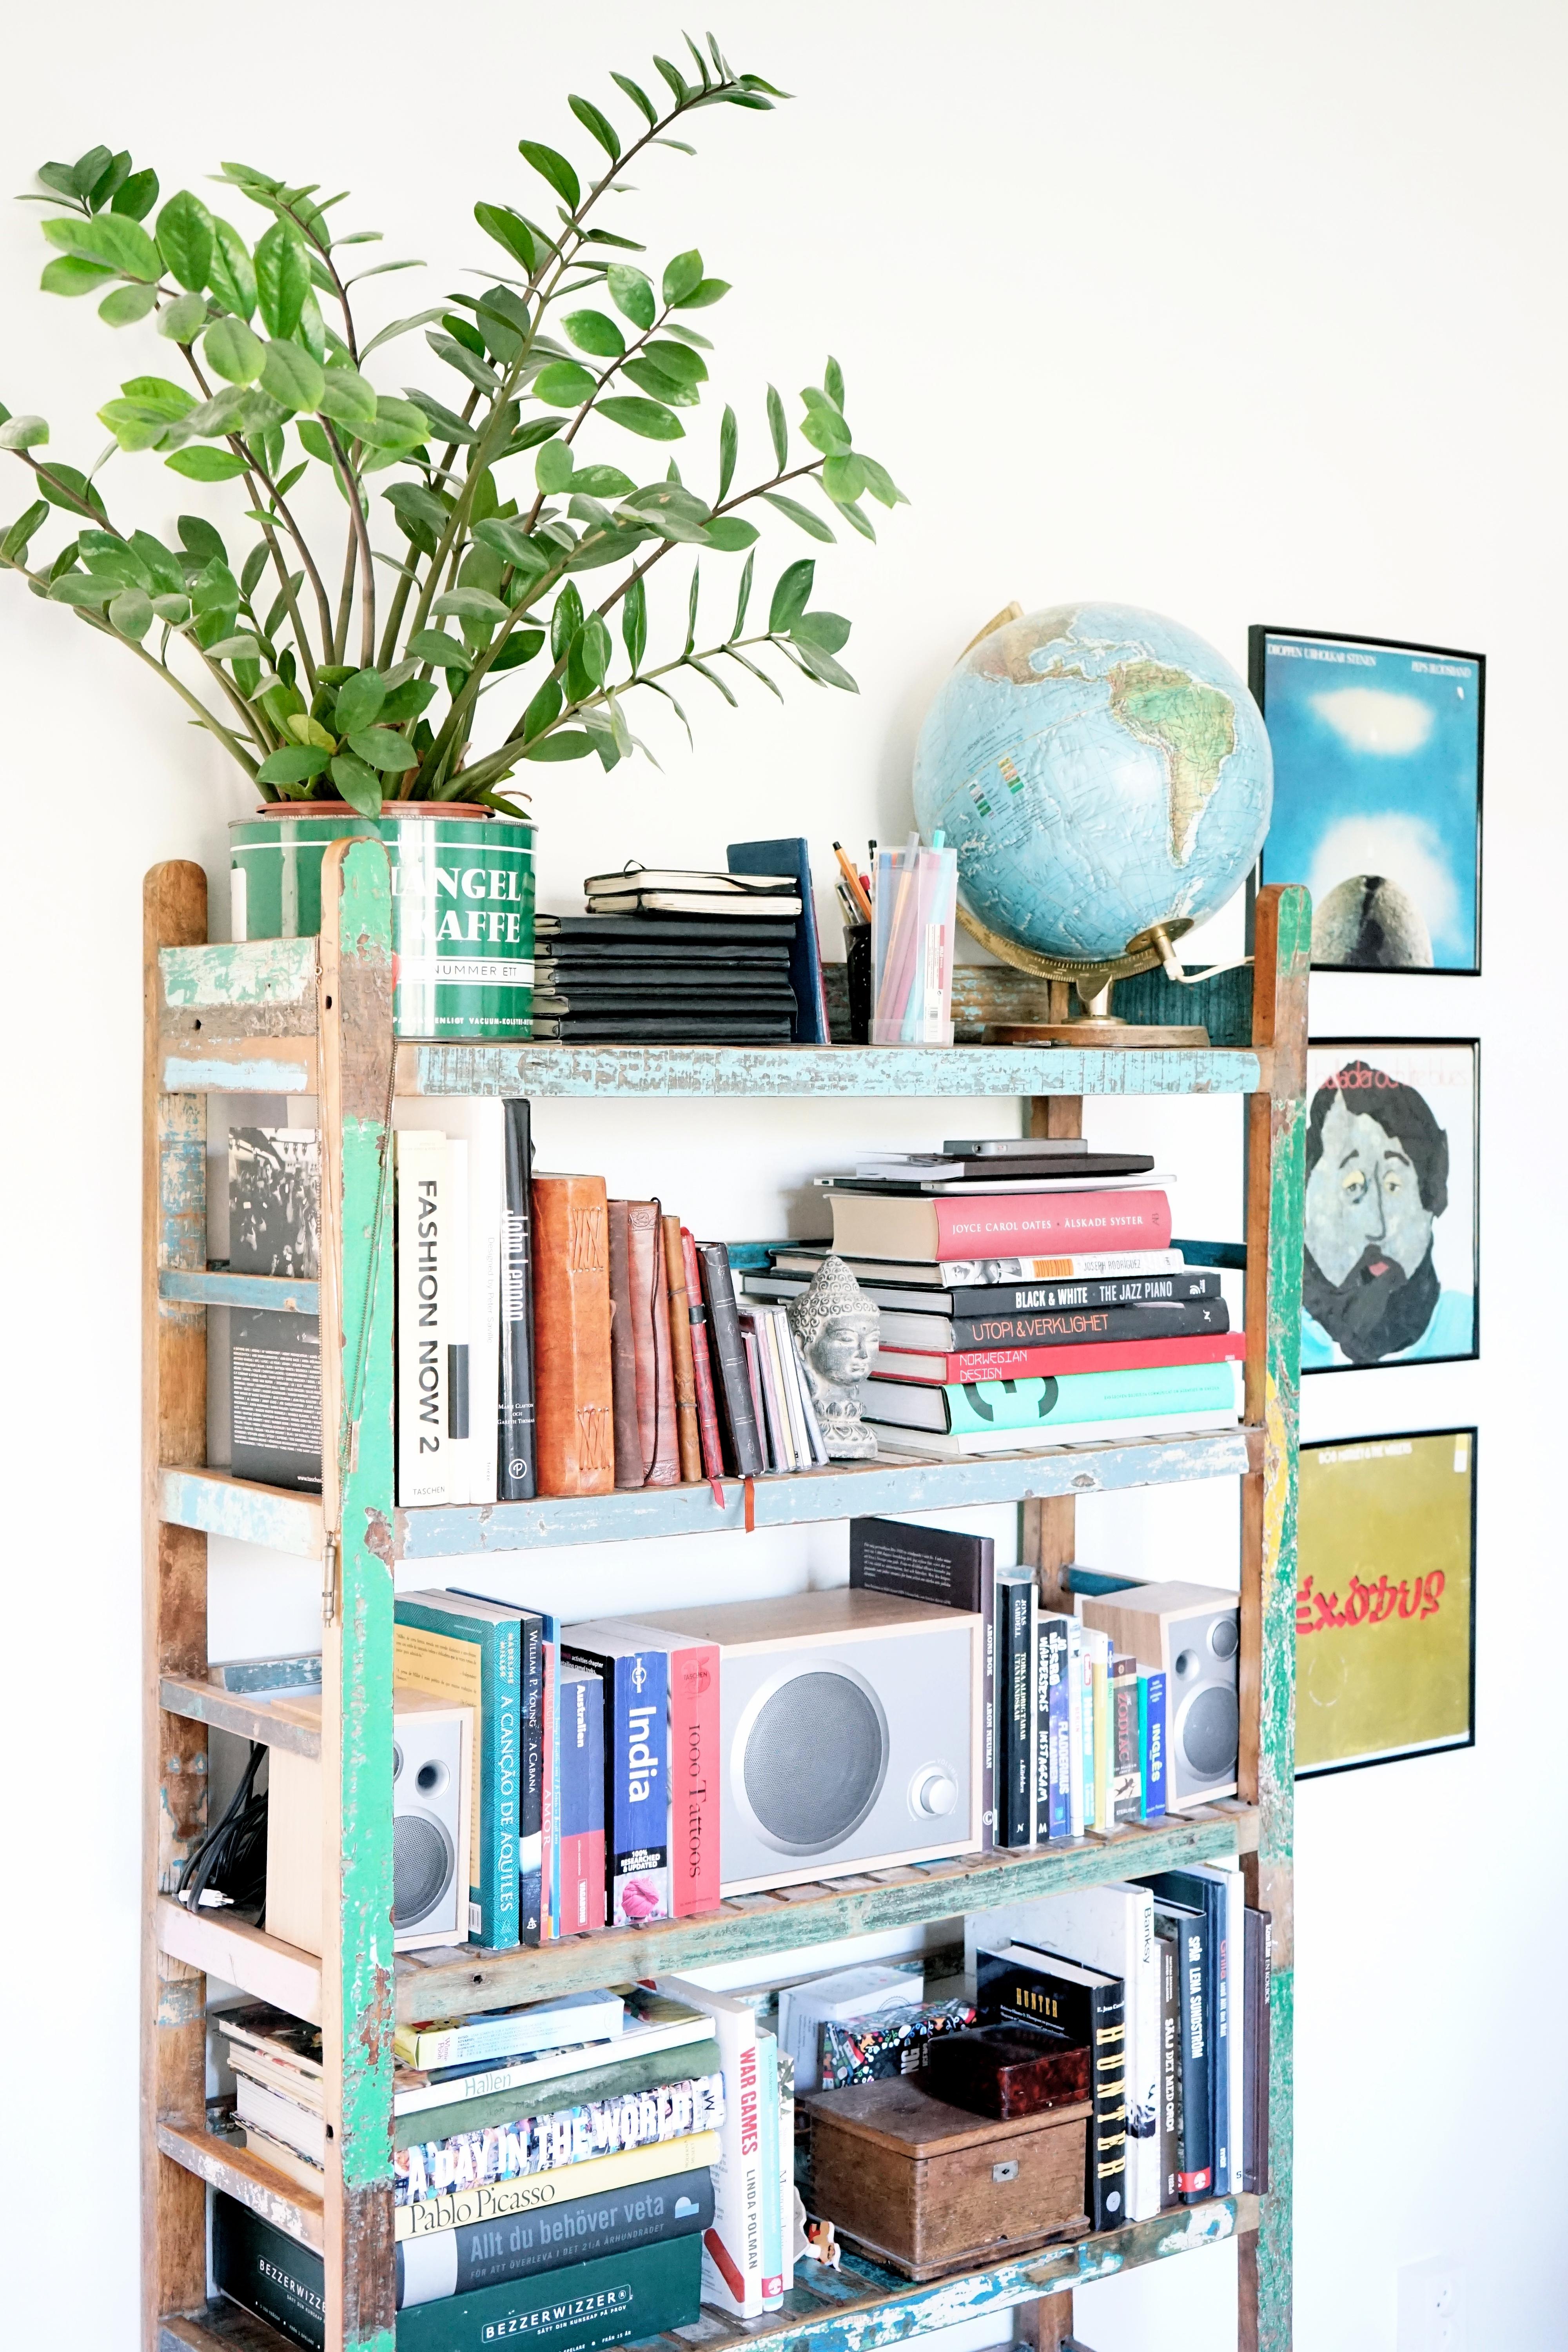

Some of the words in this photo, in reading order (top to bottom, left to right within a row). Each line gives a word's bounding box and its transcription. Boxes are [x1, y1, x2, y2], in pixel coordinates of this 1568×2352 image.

[410, 910, 520, 942] KAFFE
[435, 965, 496, 975] NUMMER
[503, 967, 517, 976] ETT
[502, 1210, 528, 1254] John
[953, 1223, 981, 1234] JOYCE
[985, 1222, 1018, 1232] CAROL
[1022, 1220, 1051, 1230] OATES
[1065, 1217, 1106, 1228] ÄLSKADE
[1111, 1216, 1143, 1225] SYSTER
[418, 1181, 437, 1327] FASHION
[1036, 1259, 1072, 1277] JUVENILE
[1084, 1261, 1105, 1271] JOSEPH
[1108, 1259, 1140, 1269] RODRÍGUEZ
[486, 1278, 494, 1289] by
[502, 1259, 529, 1322] Lennon
[1016, 1290, 1045, 1308] BLACK
[1048, 1293, 1055, 1305] &
[1058, 1287, 1087, 1305] WHITE
[1100, 1285, 1116, 1302] THE
[1120, 1283, 1142, 1300] JAZZ
[1145, 1281, 1172, 1298] PIANO
[972, 1321, 1013, 1341] UTOPI
[1025, 1314, 1108, 1336] VERKLIGHET
[960, 1350, 1027, 1366] NORWEGIAN
[419, 1341, 439, 1425] NOW
[960, 1367, 1002, 1382] DESIGN
[420, 1436, 439, 1454] 2
[413, 1486, 445, 1495] TASCHEN
[529, 1630, 538, 1675] WILLIAM
[1049, 1632, 1060, 1686] NESBØ
[1057, 1636, 1067, 1651] JO
[572, 1656, 588, 1664] activities
[588, 1659, 603, 1668] chapter
[684, 1671, 707, 1680] TASCHEN
[501, 1697, 513, 1708] A
[530, 1690, 538, 1727] YOUNG
[577, 1685, 586, 1748] Australien
[1117, 1692, 1130, 1762] ZODIAC
[498, 1713, 515, 1796] CANÇÃO
[629, 1706, 658, 1803] India
[689, 1724, 700, 1777] 1000
[1049, 1735, 1058, 1784] MANNEN
[1058, 1721, 1069, 1795] FLADDERMUS
[1152, 1723, 1163, 1782] INGLÊS
[1037, 1731, 1049, 1802] INSTAGRAM
[501, 1802, 513, 1826] DE
[1116, 1807, 1136, 1816] STERLING
[689, 1780, 707, 1879] Tattoos
[621, 1853, 660, 1867] RESEARCHED
[628, 1861, 657, 1871] UPDATED
[632, 1849, 647, 1858] 100%
[498, 1832, 513, 1912] AQUILES
[1188, 1936, 1203, 1963] SPÅR
[1265, 1959, 1271, 1971] EN
[1189, 1967, 1201, 1995] LENA
[1016, 1987, 1058, 2018] HUNTER
[1165, 2018, 1174, 2049] SÄLJ
[1190, 1999, 1204, 2059] SUNDSTRÖM
[740, 2046, 756, 2089] WAR
[1165, 2051, 1174, 2074] DET
[465, 2073, 511, 2097] Hallen
[1096, 2022, 1125, 2179] HUNTER
[1166, 2075, 1174, 2102] MED
[741, 2091, 758, 2156] GAMES
[407, 2150, 427, 2196] A
[435, 2140, 491, 2189] DAY
[497, 2131, 527, 2173] IN
[534, 2116, 590, 2160] THE
[596, 2092, 692, 2149] WORLD
[747, 2169, 756, 2210] LINDA
[409, 2194, 471, 2234] Pablo
[475, 2184, 555, 2218] Picasso
[470, 2231, 503, 2263] Allt
[510, 2225, 533, 2252] du
[540, 2207, 618, 2245] behöver
[624, 2195, 664, 2223] veta
[748, 2213, 758, 2270] POLMAN
[471, 2270, 486, 2279] FÖR
[490, 2263, 506, 2274] ATT
[510, 2251, 552, 2269] ÖVERLEVA
[563, 2245, 578, 2256] DET
[604, 2223, 665, 2246] ÅRHUNDRADET
[305, 2307, 322, 2321] KUNSKAP
[537, 2326, 553, 2335] SÄTT
[570, 2313, 598, 2326] KUNSKAP
[611, 2305, 626, 2313] PROV
